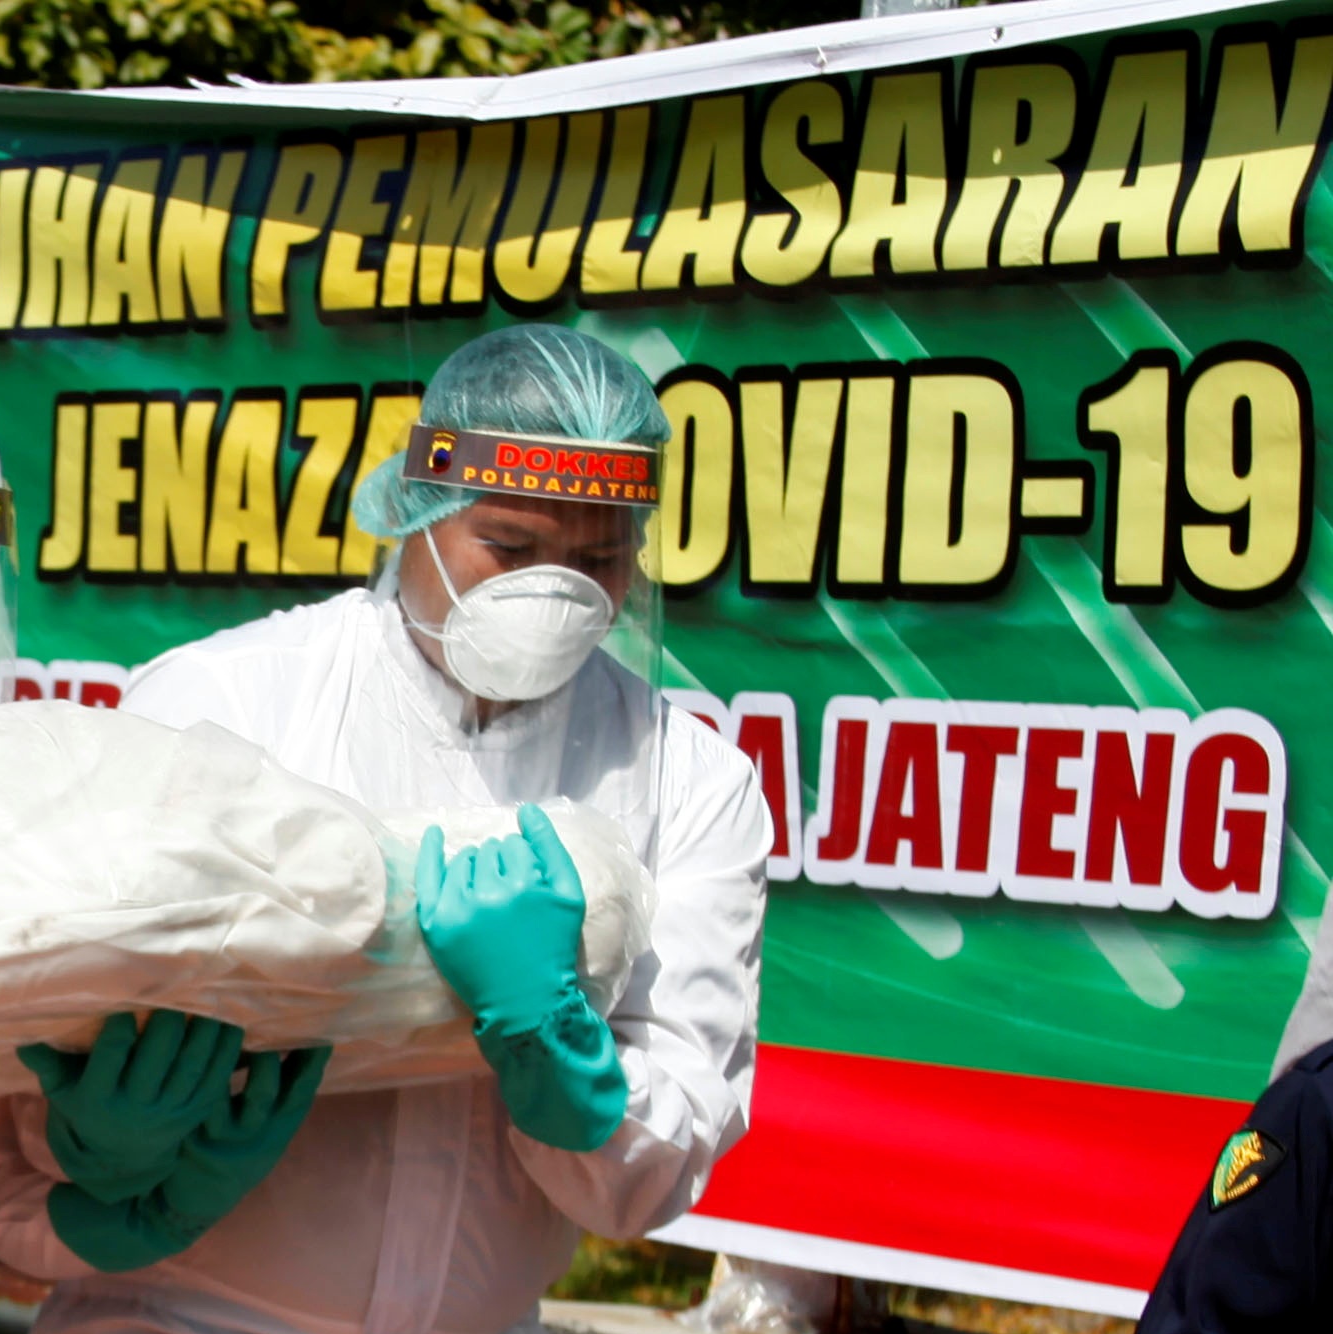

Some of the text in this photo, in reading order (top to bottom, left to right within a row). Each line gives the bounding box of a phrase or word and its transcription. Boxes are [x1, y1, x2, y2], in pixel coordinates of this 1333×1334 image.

[249, 33, 1333, 318] PEMULASARAN
[37, 358, 1303, 593] JENAZA OVID-19
[495, 443, 649, 482] DOKKES
[815, 717, 1271, 896] JATENG
